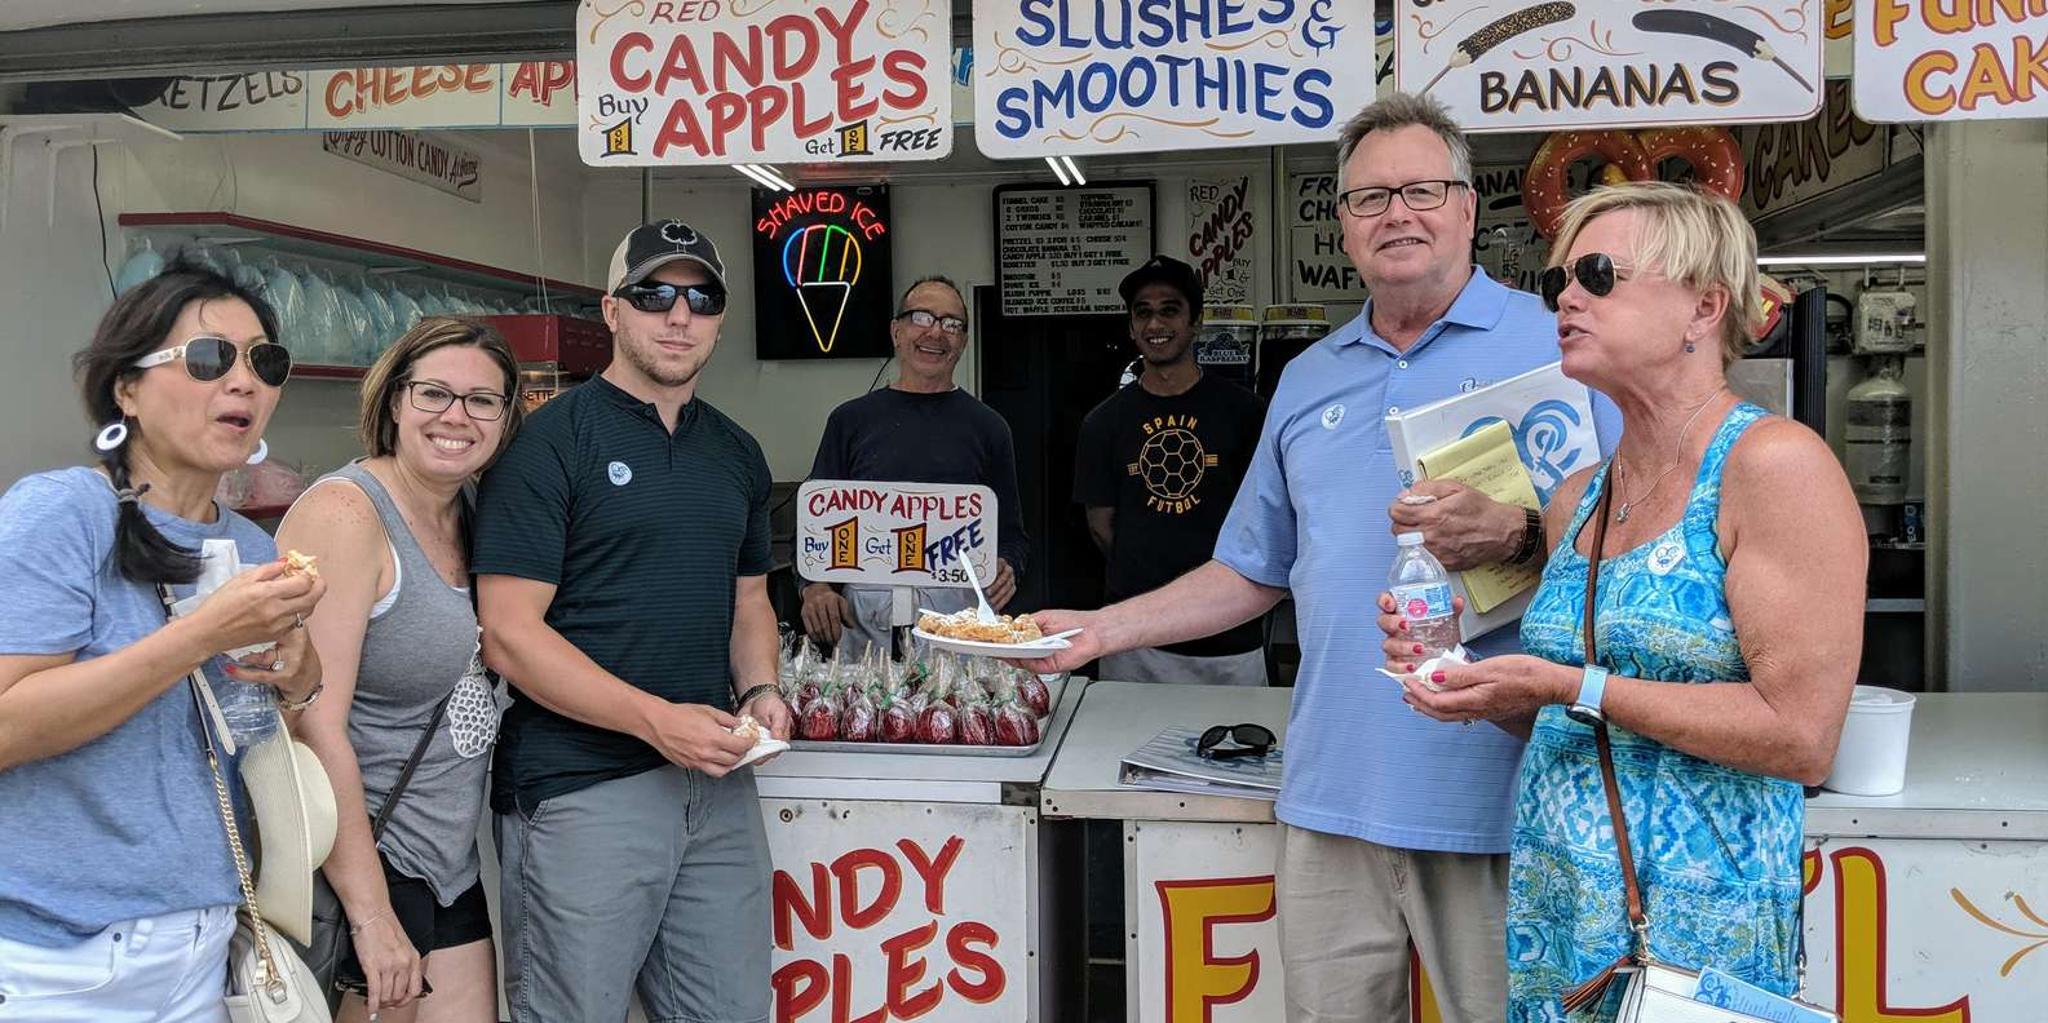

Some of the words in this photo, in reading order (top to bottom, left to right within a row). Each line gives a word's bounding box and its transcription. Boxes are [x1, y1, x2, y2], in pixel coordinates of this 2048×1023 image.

[650, 0, 721, 25] RED
[1301, 0, 1348, 57] &
[609, 0, 870, 97] CANDY
[160, 71, 303, 112] ETZELS
[325, 63, 495, 121] CHEESE
[598, 93, 649, 125] Buy
[652, 49, 929, 159] APPLES
[994, 53, 1335, 140] SMOOTHIES
[1479, 61, 1741, 114] BANANAS
[370, 130, 416, 169] COTTON
[417, 141, 449, 181] CANDY
[805, 137, 835, 156] Get
[879, 127, 943, 152] FREE
[756, 191, 845, 240] SHAVED
[850, 201, 886, 241] ICE
[1189, 176, 1249, 257] CANDY
[1190, 185, 1219, 202] RED
[1142, 413, 1199, 435] SPAIN
[808, 488, 889, 518] CANDY
[890, 492, 983, 521] APPLES
[1146, 494, 1201, 514] FUTBOL
[804, 536, 829, 560] Buy
[838, 527, 850, 564] ONE
[865, 536, 893, 555] Get
[905, 531, 917, 567] ONE
[925, 518, 985, 572] FREE
[772, 834, 967, 951] NDY
[771, 919, 1007, 1023] PLES
